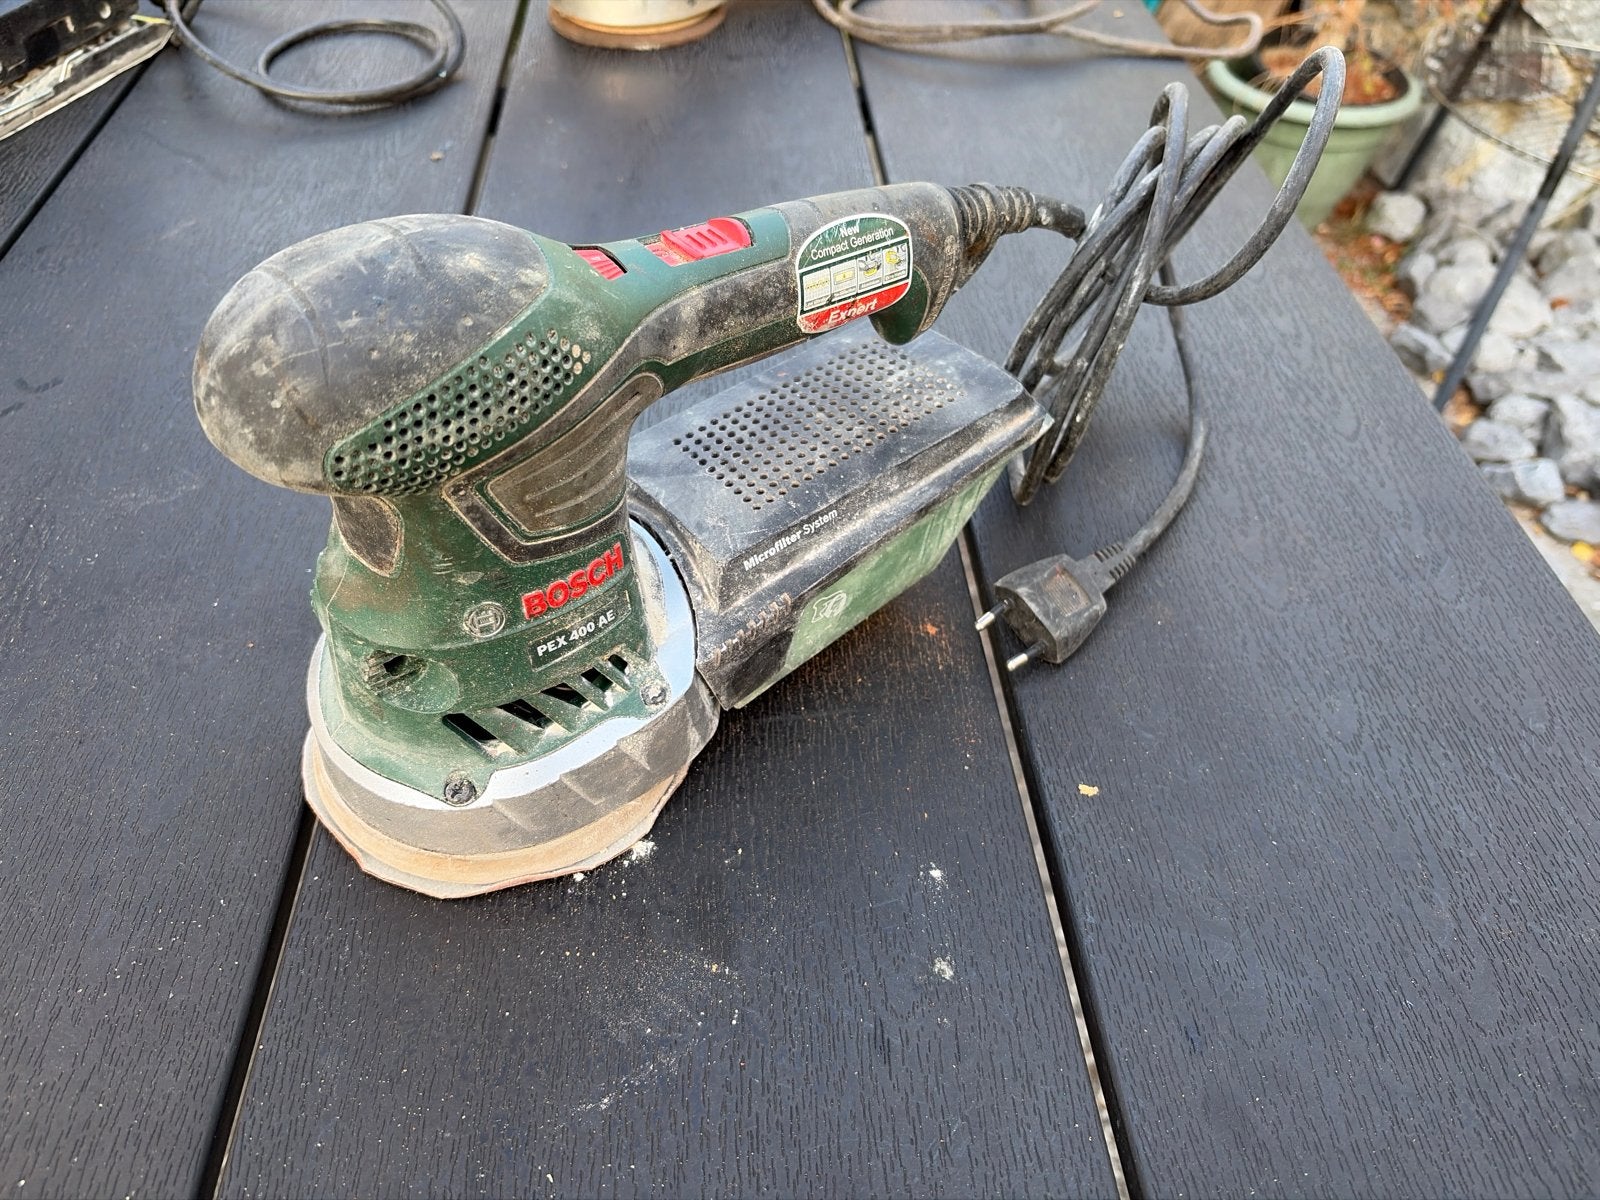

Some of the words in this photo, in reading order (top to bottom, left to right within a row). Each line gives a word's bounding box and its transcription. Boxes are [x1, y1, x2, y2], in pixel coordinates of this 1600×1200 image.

[811, 242, 850, 260] Compact
[850, 227, 894, 247] Generation
[840, 224, 860, 238] New
[743, 530, 802, 571] Microfilter
[802, 509, 838, 535] System
[522, 541, 624, 620] BOSCH
[536, 635, 568, 657] PEX
[569, 621, 595, 641] 400
[598, 609, 616, 628] AE
